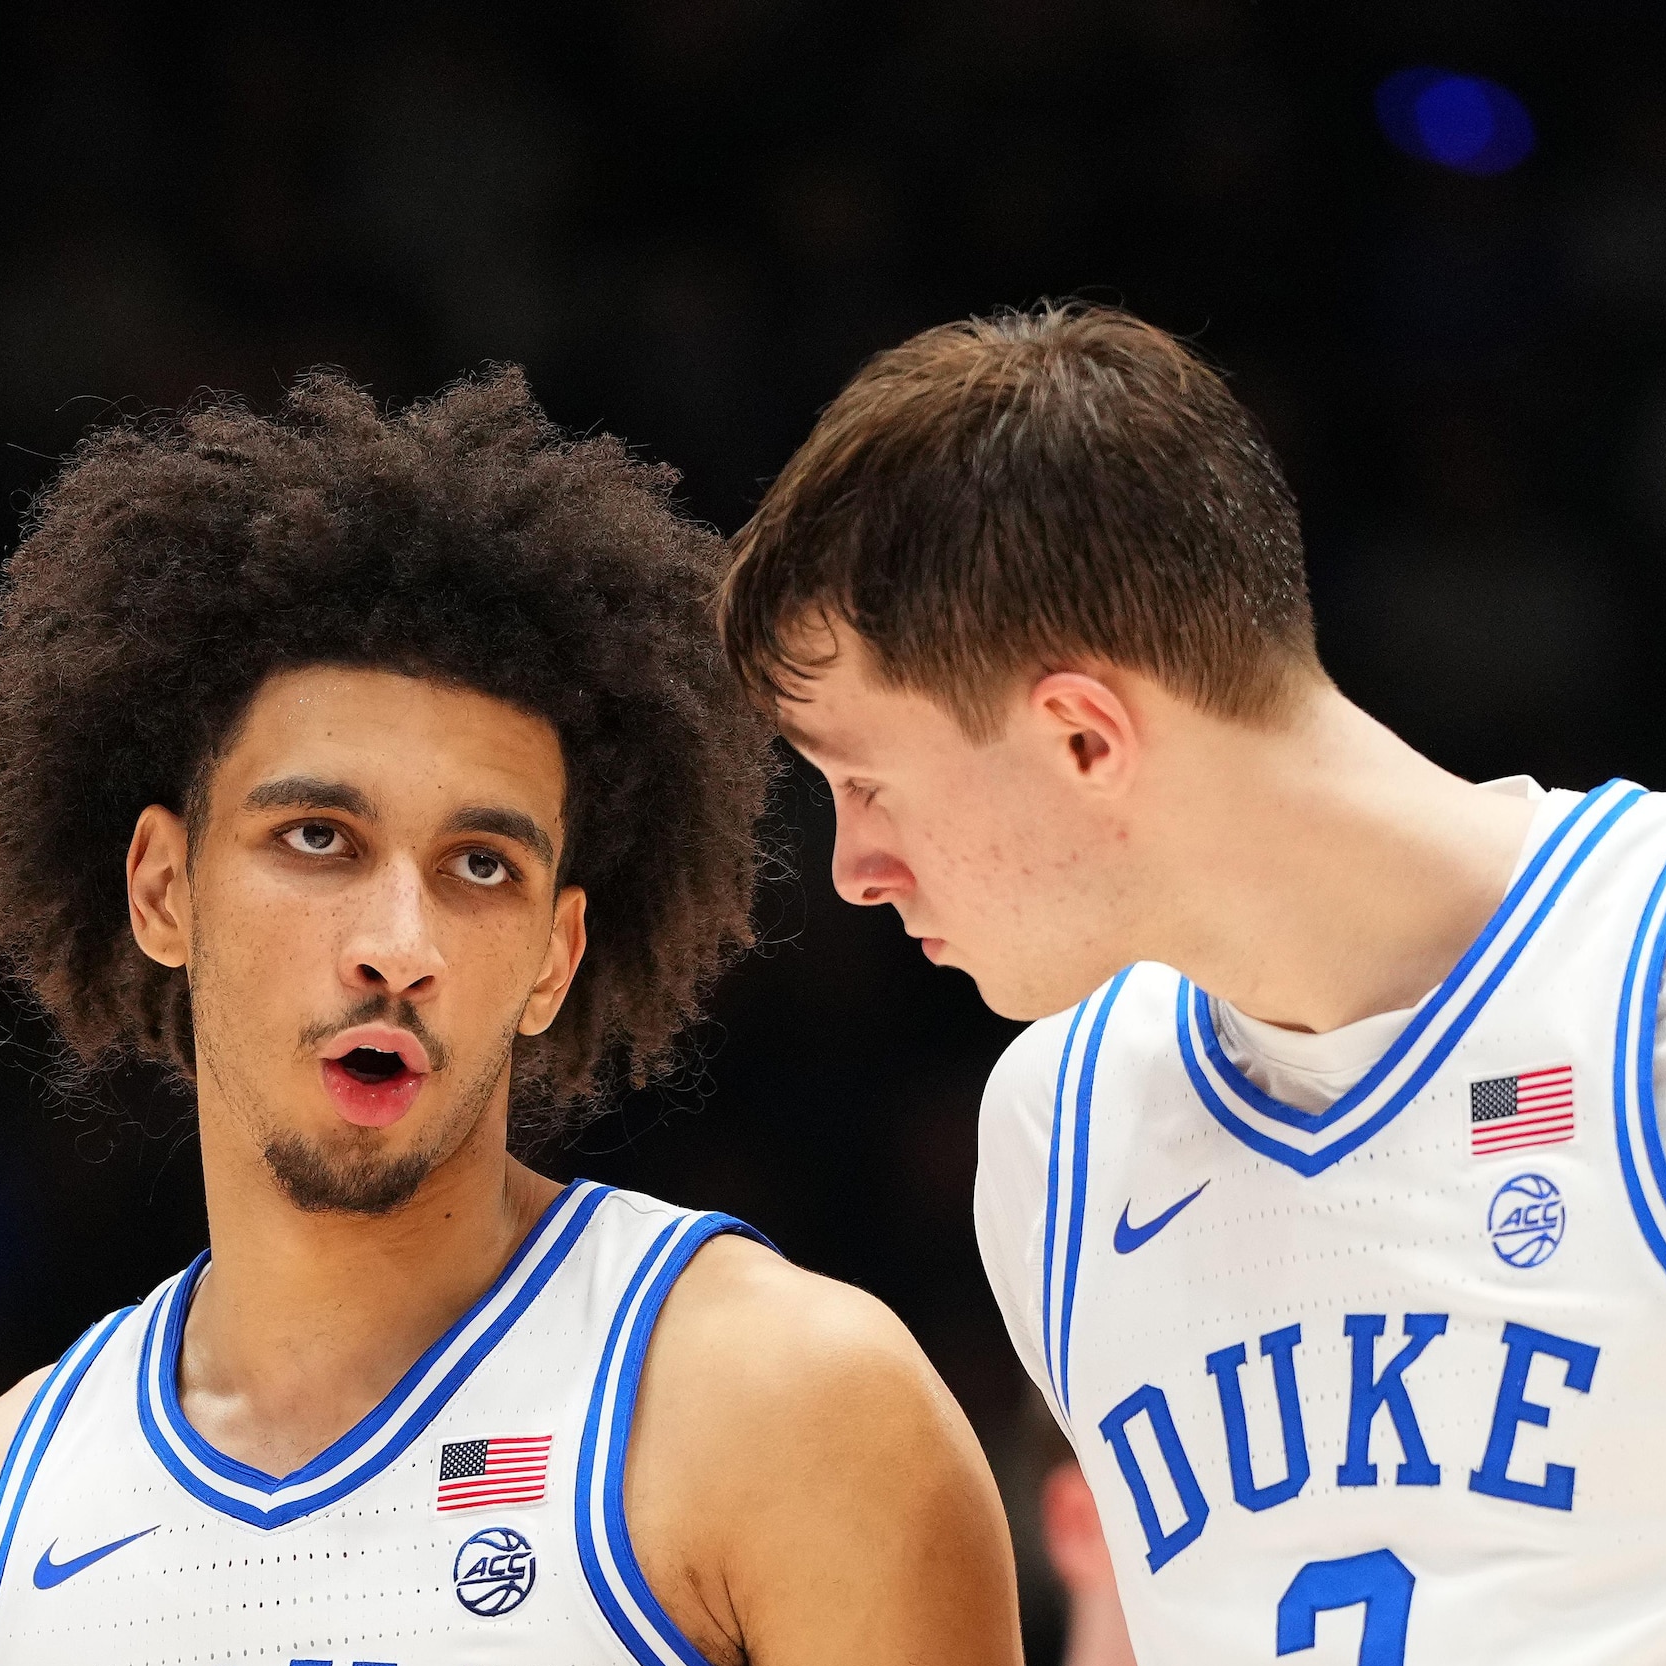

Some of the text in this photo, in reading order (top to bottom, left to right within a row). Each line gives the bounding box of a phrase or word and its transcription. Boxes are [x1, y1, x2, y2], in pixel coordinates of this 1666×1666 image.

[1498, 1199, 1562, 1229] ACC
[1100, 1313, 1601, 1575] DUKE
[462, 1551, 532, 1579] ACC
